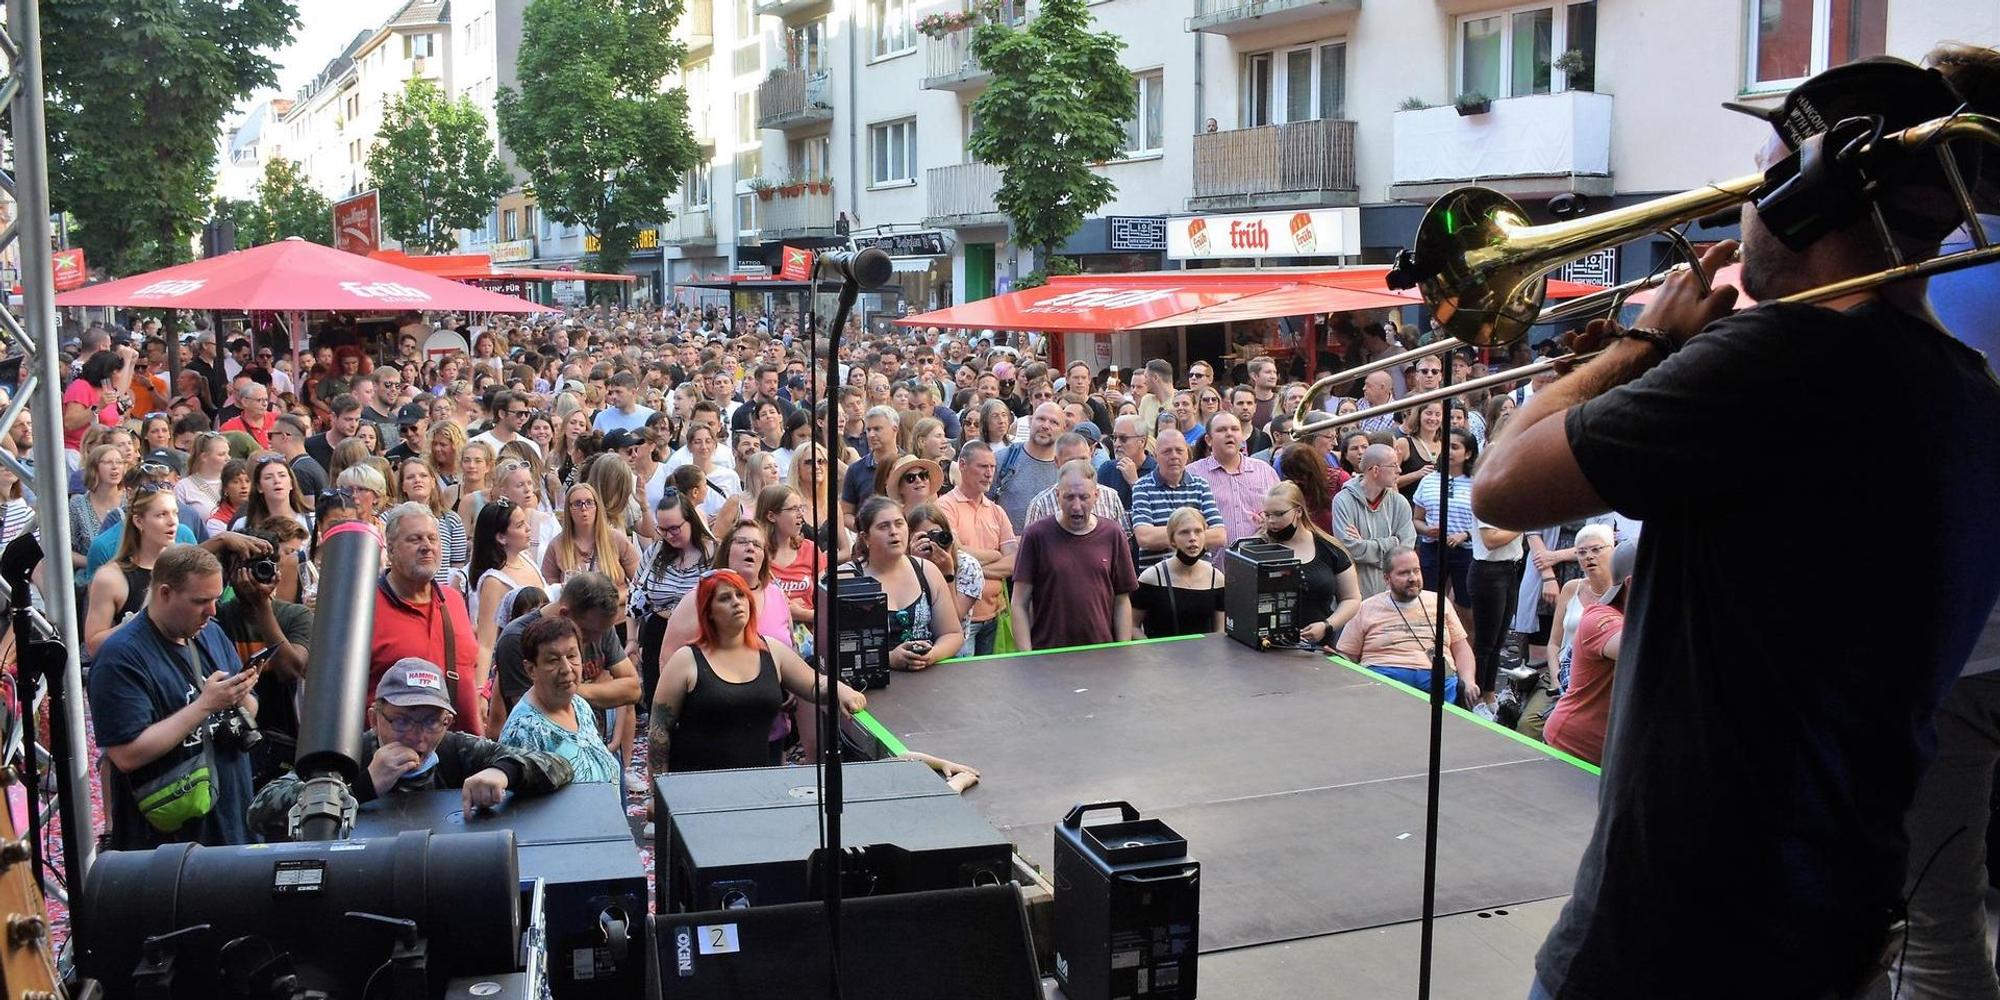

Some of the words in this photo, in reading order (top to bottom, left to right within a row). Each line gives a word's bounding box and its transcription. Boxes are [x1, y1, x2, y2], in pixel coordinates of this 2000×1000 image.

[1229, 219, 1269, 252] früh
[1295, 228, 1313, 246] früh
[409, 672, 438, 681] HAMMER
[710, 928, 725, 948] 2
[677, 932, 692, 976] NEXO
